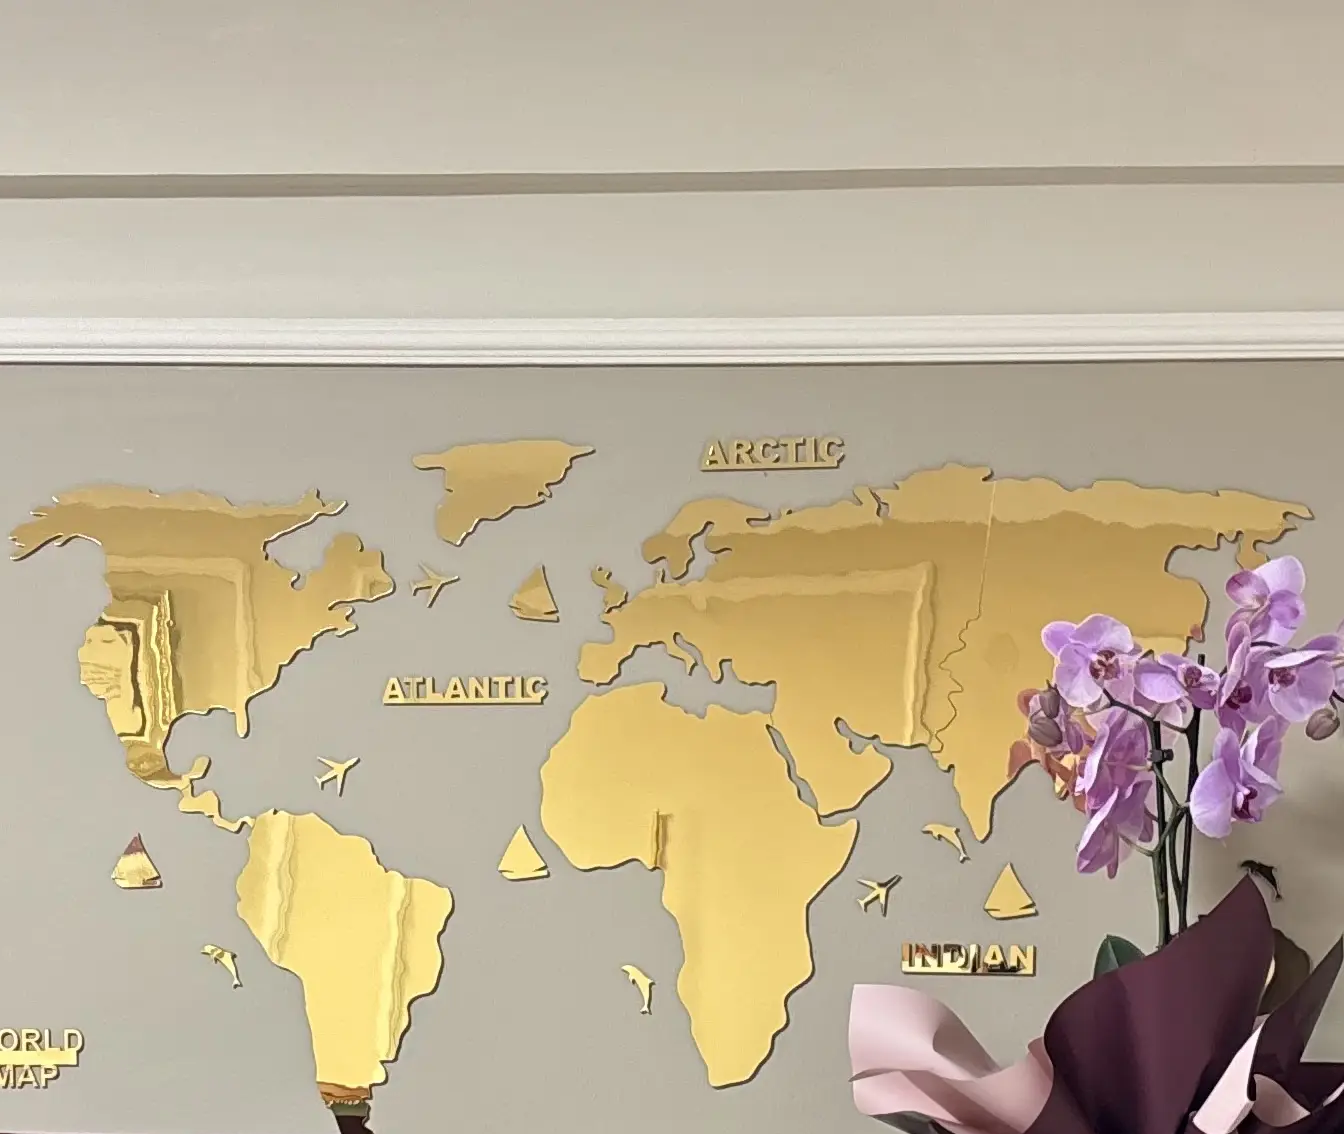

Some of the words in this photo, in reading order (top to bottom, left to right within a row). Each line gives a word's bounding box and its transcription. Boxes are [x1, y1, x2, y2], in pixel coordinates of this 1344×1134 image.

[700, 436, 845, 472] ARCTIC
[382, 676, 548, 705] ATLANTIC
[902, 944, 1037, 976] INDIAN
